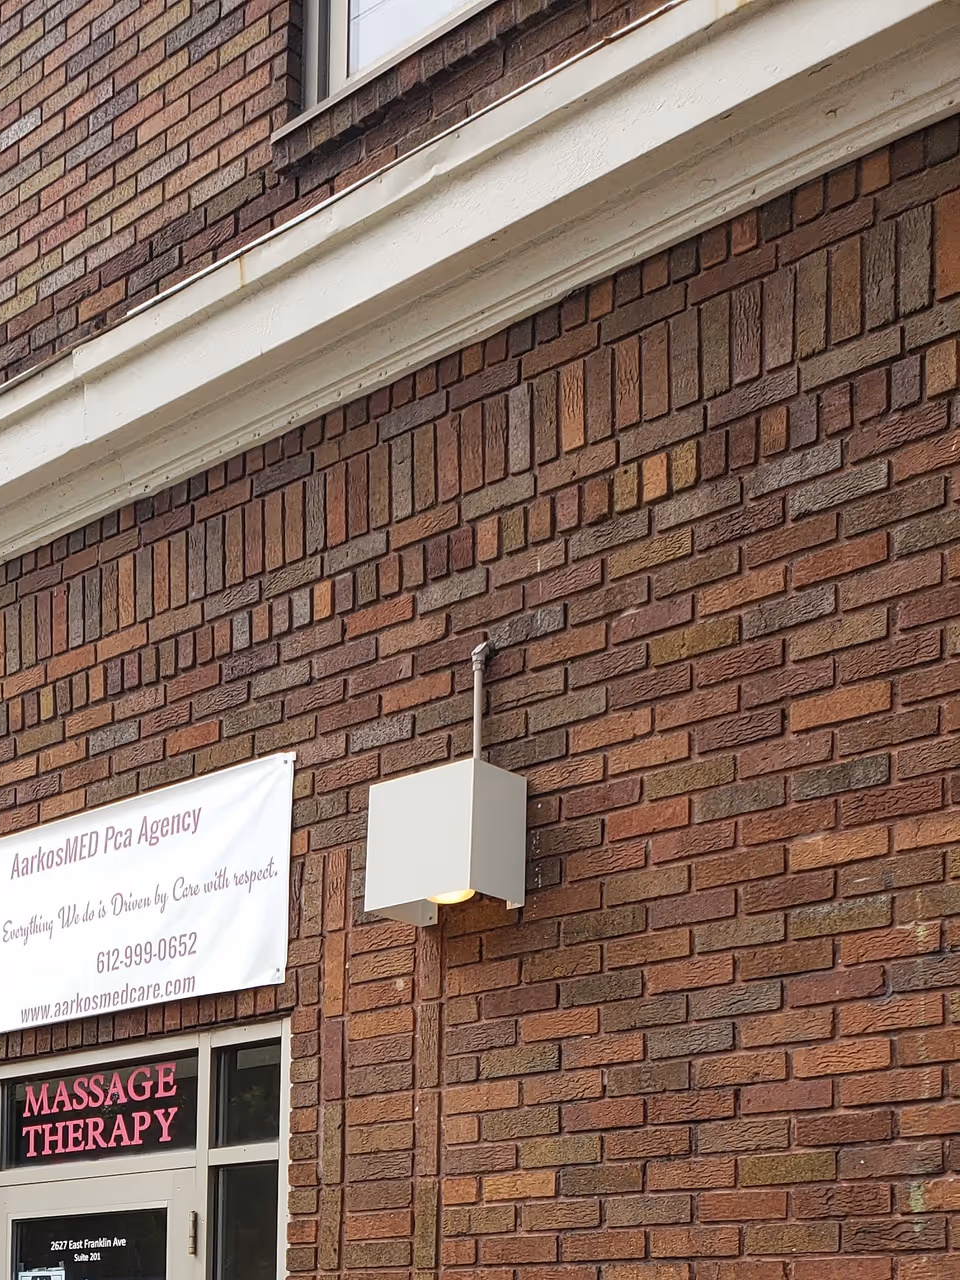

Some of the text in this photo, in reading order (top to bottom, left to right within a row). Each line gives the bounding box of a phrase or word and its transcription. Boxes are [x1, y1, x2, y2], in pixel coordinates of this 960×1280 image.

[10, 807, 202, 880] AarkosMED Pca Agency
[2, 856, 278, 946] Everything We do is Driven by Care with respect.
[96, 931, 198, 974] 612-999-0652
[20, 975, 196, 1024] www.aarkosmedcare.com
[22, 1062, 177, 1118] MASSAGE
[22, 1107, 178, 1158] THERAPY
[50, 1236, 127, 1251] 2627 East Franklin Ave
[73, 1252, 101, 1262] Suite 201
